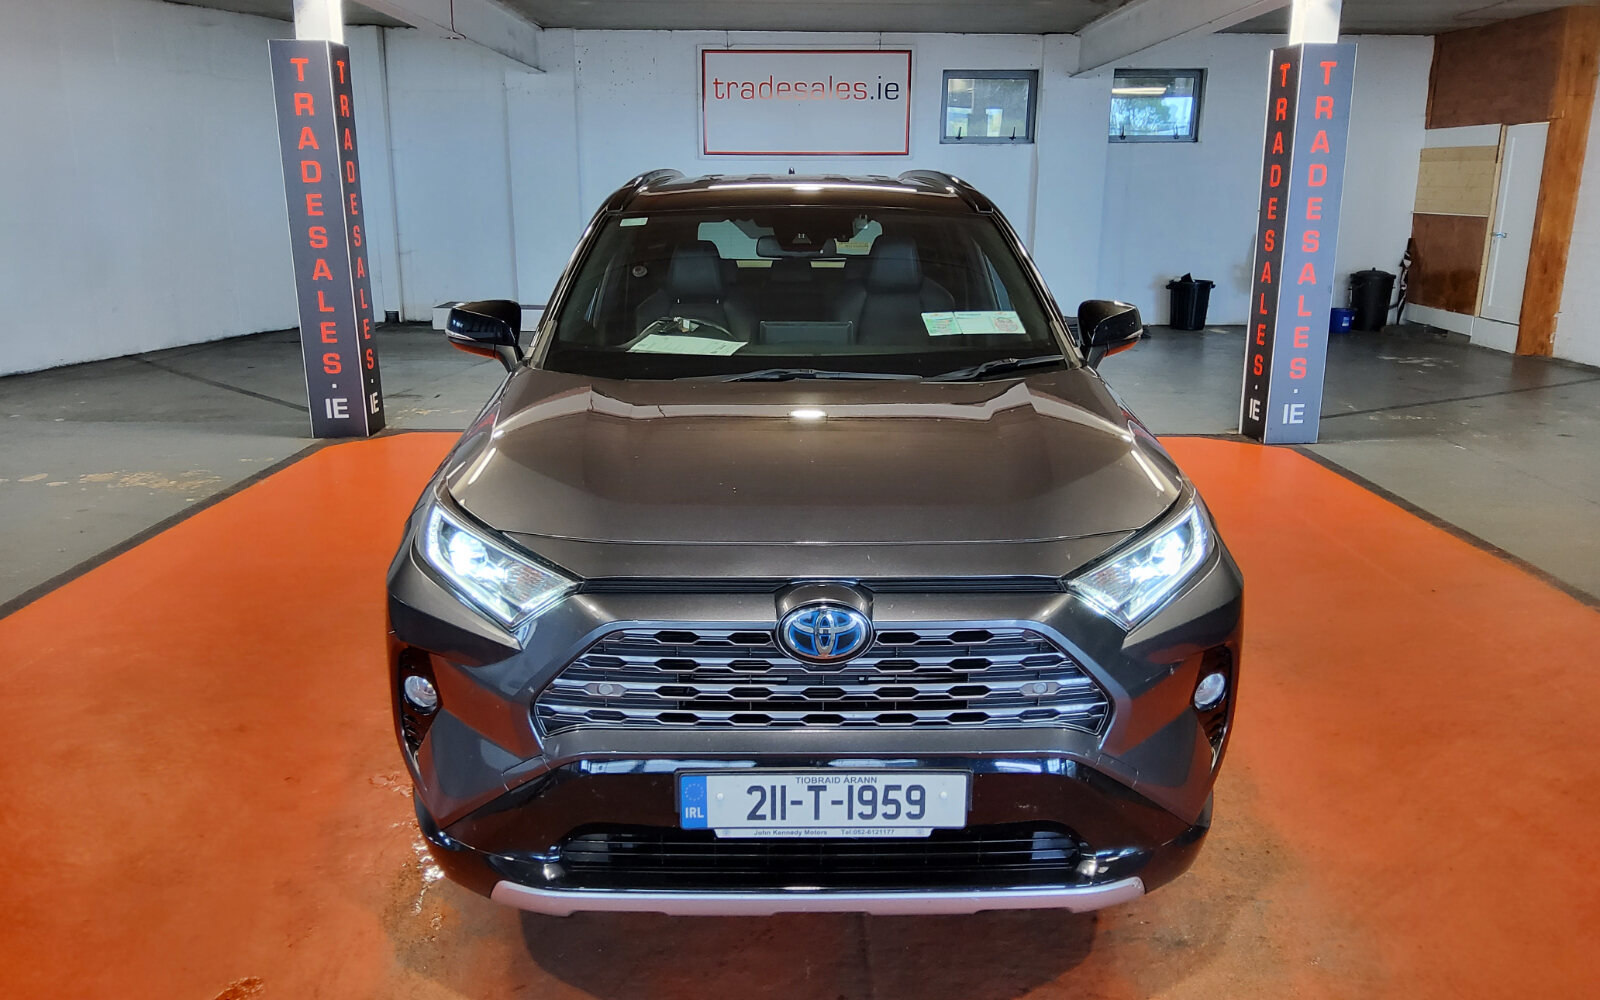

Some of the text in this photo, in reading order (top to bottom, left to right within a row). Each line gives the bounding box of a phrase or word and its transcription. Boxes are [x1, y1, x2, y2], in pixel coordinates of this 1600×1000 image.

[712, 75, 900, 101] tradesales.ie
[795, 776, 841, 784] TIOBRAID
[746, 784, 926, 821] 211-T-1959
[685, 807, 705, 819] IRL
[773, 829, 803, 837] Kennedy
